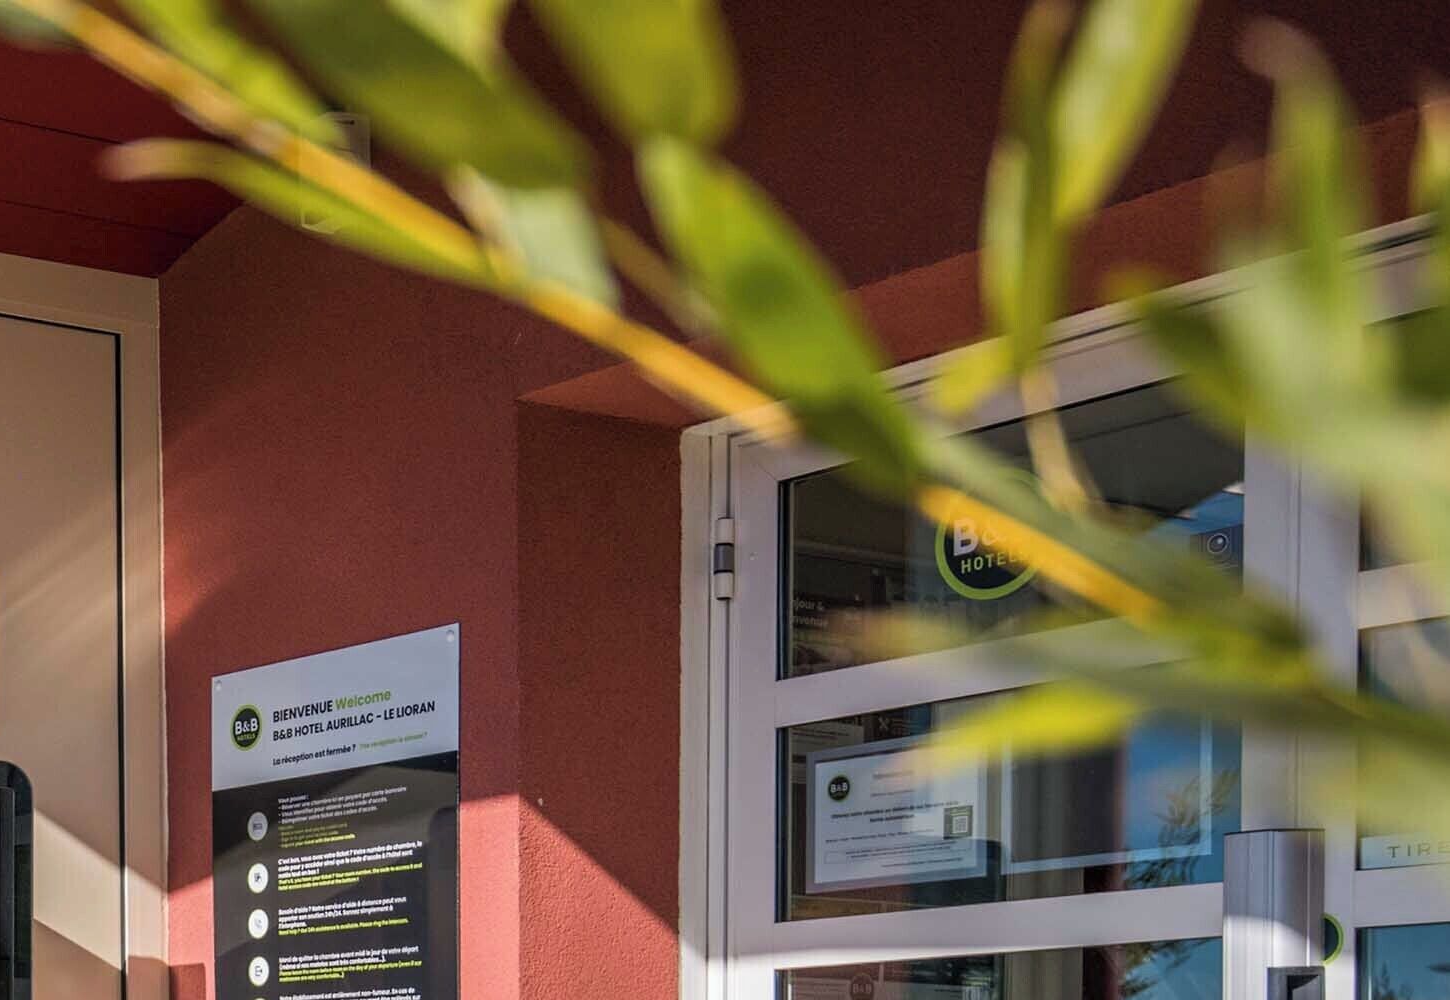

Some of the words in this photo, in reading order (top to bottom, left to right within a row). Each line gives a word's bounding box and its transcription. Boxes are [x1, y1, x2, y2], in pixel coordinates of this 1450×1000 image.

[272, 700, 333, 724] BIENVENUE
[335, 690, 392, 711] Welcome
[234, 718, 259, 734] B&B
[272, 727, 292, 742] B&B
[294, 722, 325, 738] HOTEL
[326, 713, 374, 732] AURILLAC
[384, 709, 396, 720] LE
[397, 701, 435, 718] LIORAN
[282, 751, 314, 766] réception
[315, 749, 325, 759] est
